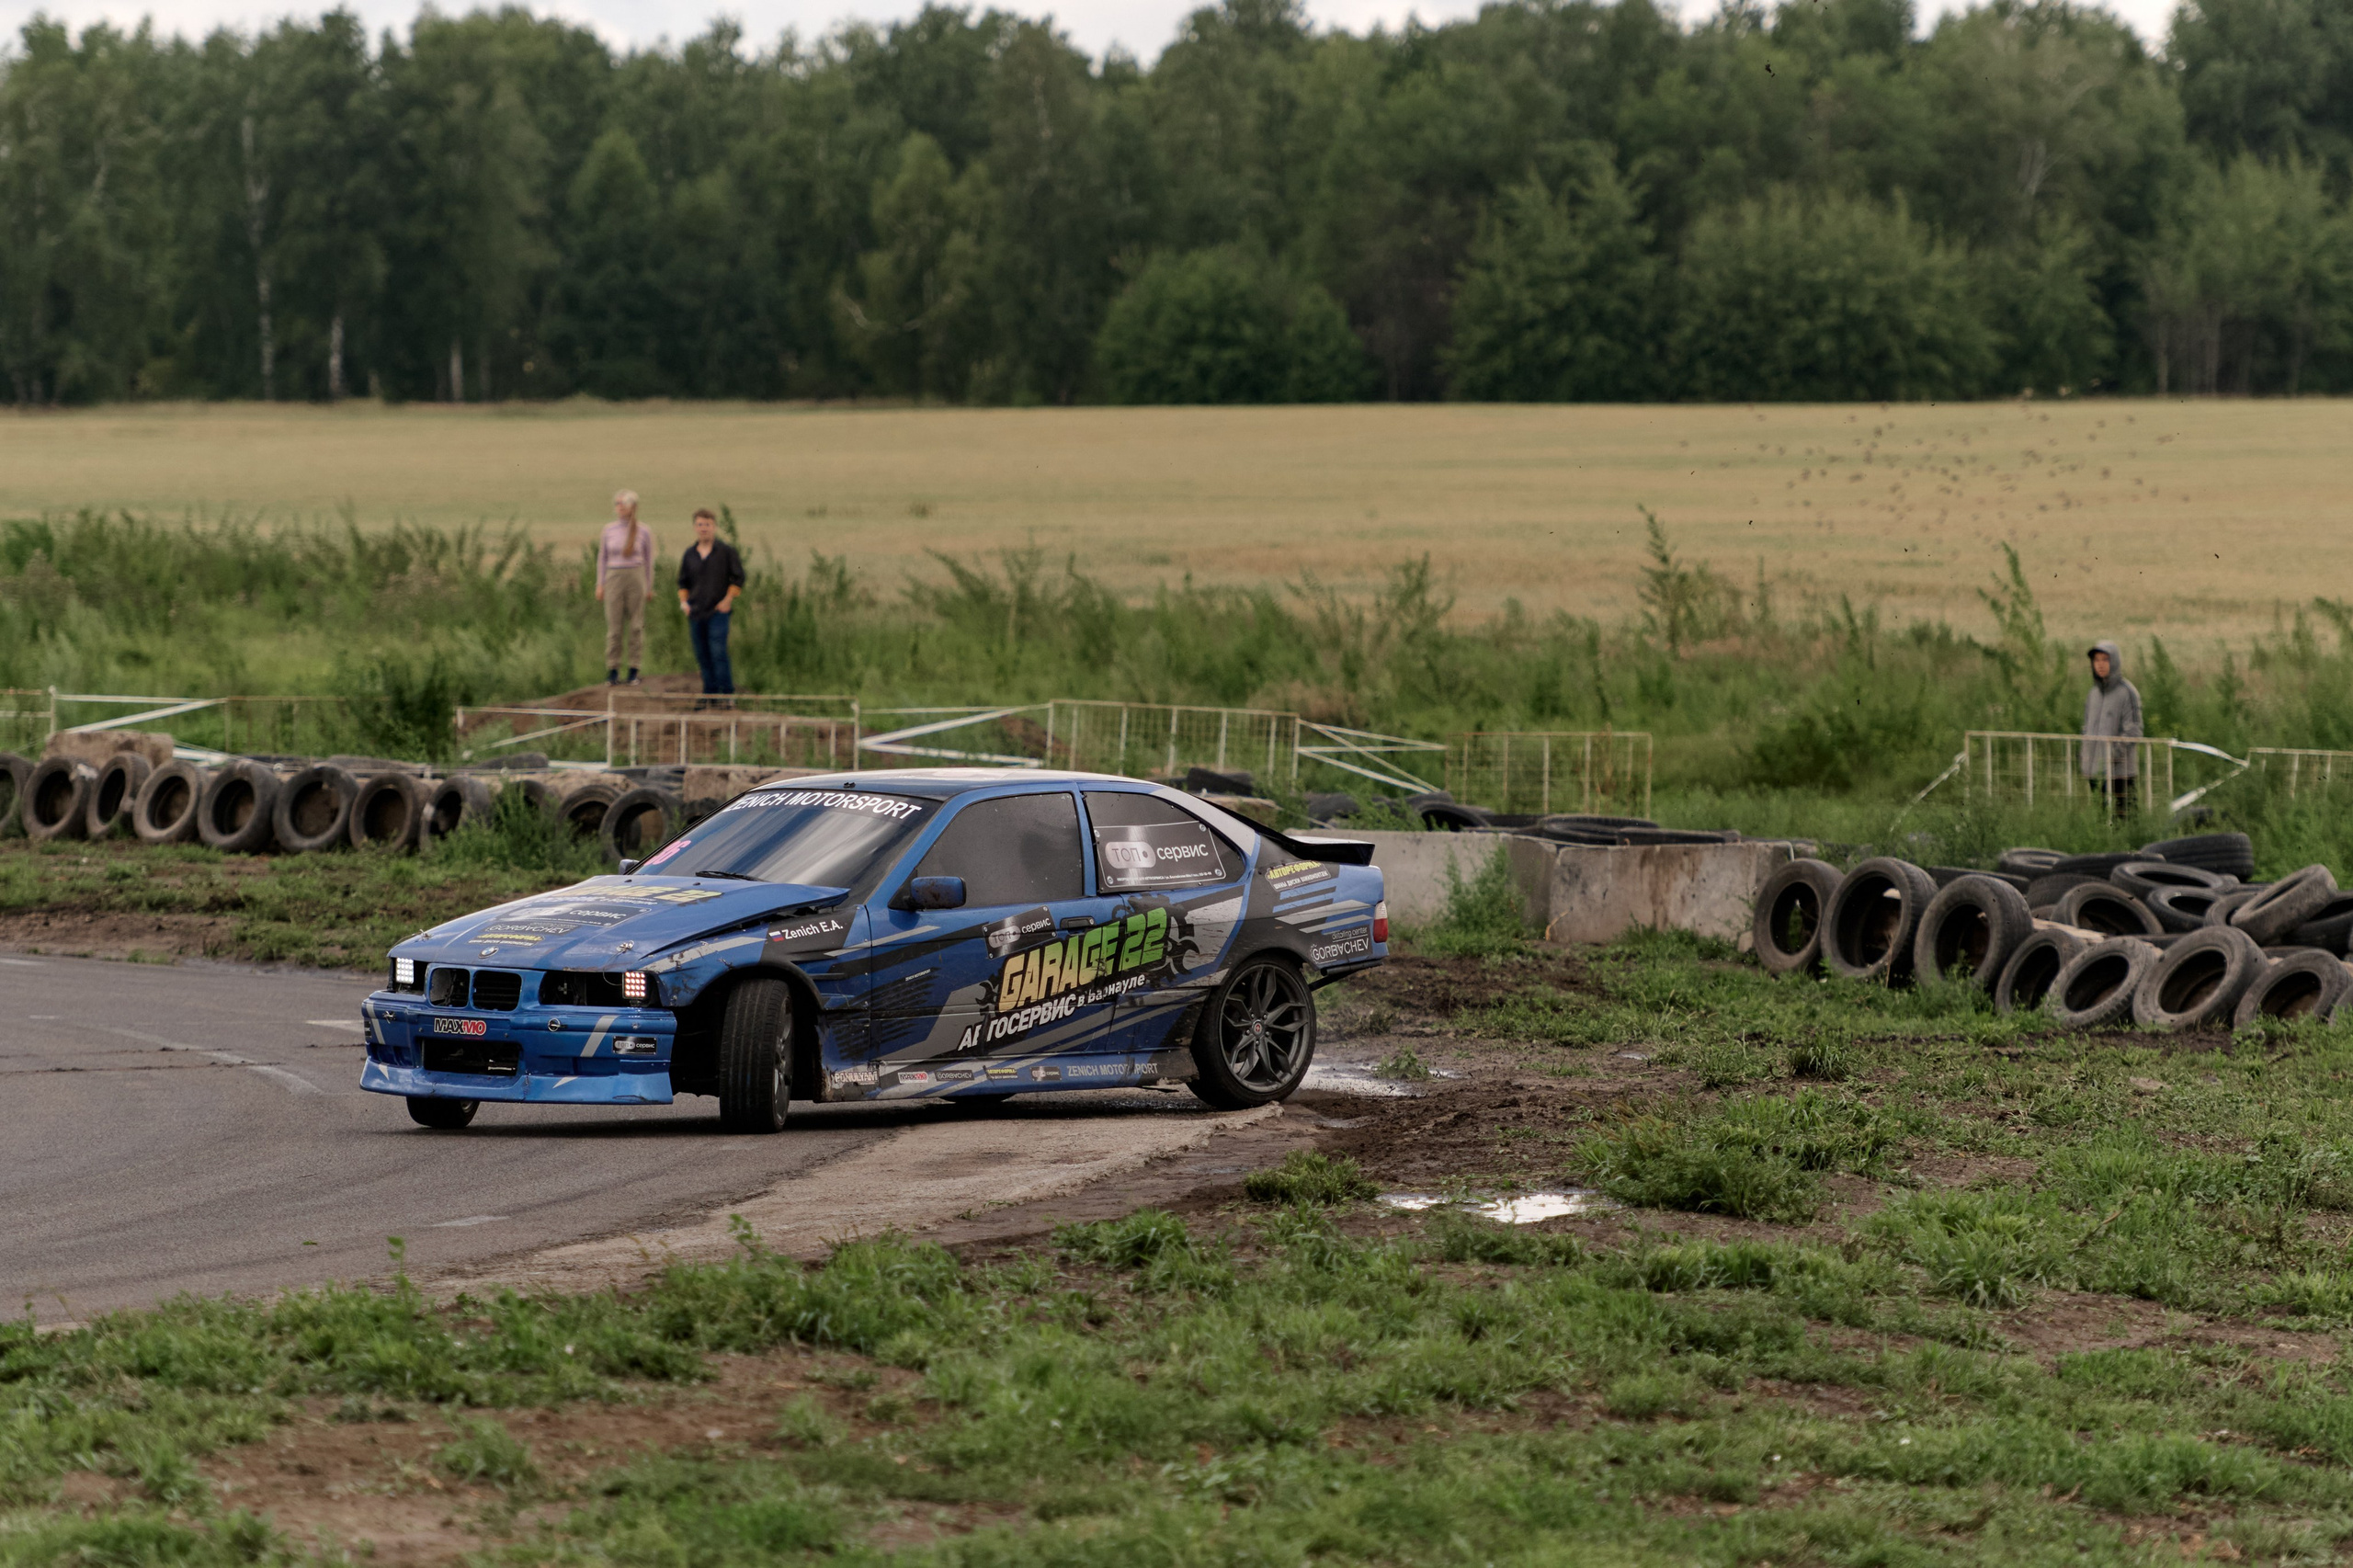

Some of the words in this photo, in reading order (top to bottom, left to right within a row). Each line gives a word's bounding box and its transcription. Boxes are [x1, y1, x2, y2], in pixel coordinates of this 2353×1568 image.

[785, 792, 922, 819] MOTORSPORT
[1156, 844, 1209, 862] сервис
[781, 925, 820, 940] Zenich
[819, 919, 844, 933] E.A.
[1021, 917, 1051, 935] сервис
[999, 921, 1120, 1012] GARAGE
[1119, 906, 1167, 971] 22
[434, 1017, 486, 1036] MAXMO
[1067, 1064, 1099, 1076] ZENICH
[1099, 1063, 1159, 1075] MOTOPORT
